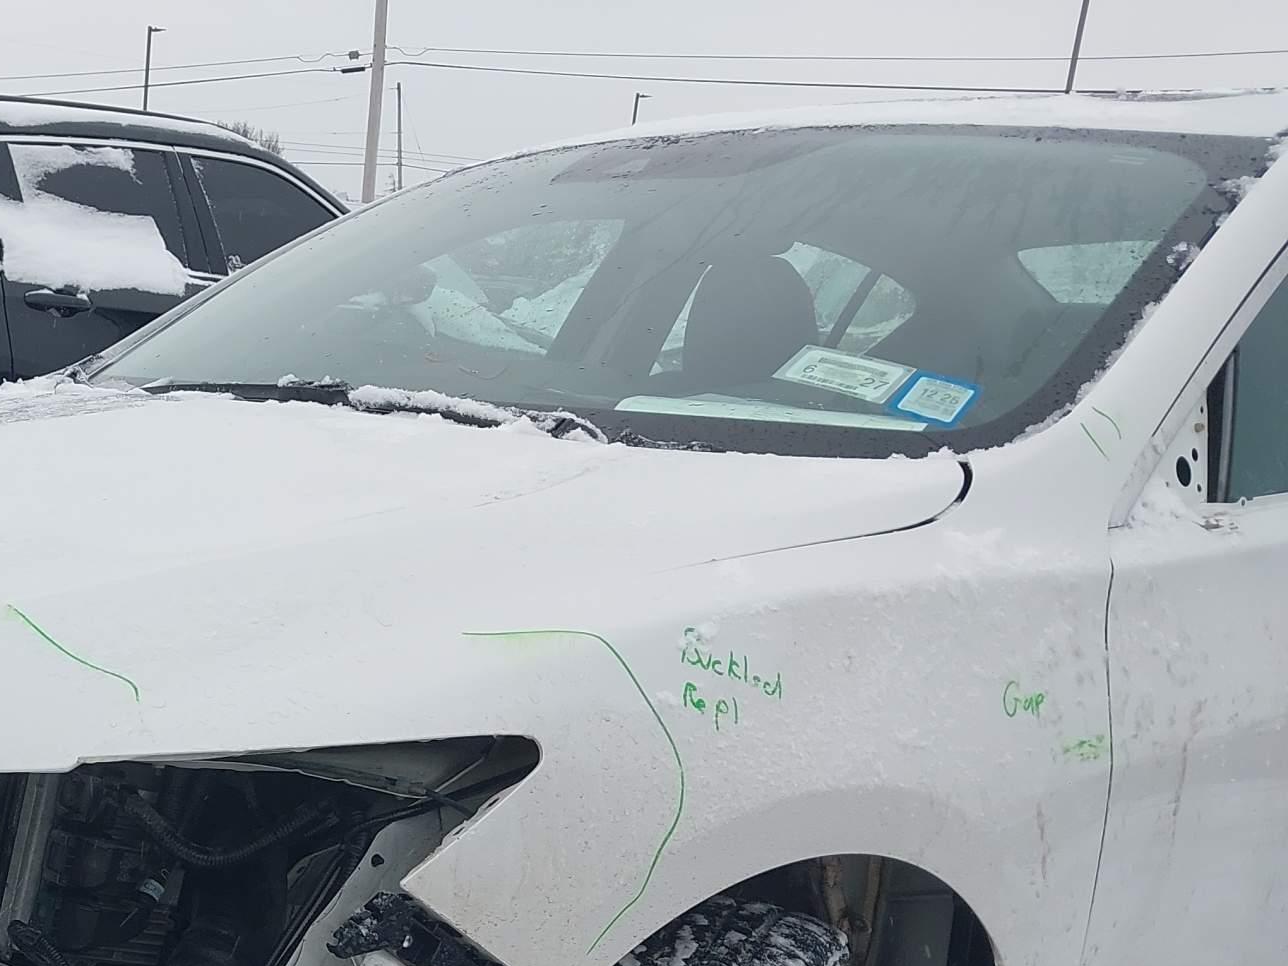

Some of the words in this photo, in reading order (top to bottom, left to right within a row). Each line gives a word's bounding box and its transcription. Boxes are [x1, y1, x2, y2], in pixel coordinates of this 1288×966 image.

[859, 377, 890, 390] 27
[921, 387, 938, 399] 12
[1003, 680, 1045, 720] Gap
